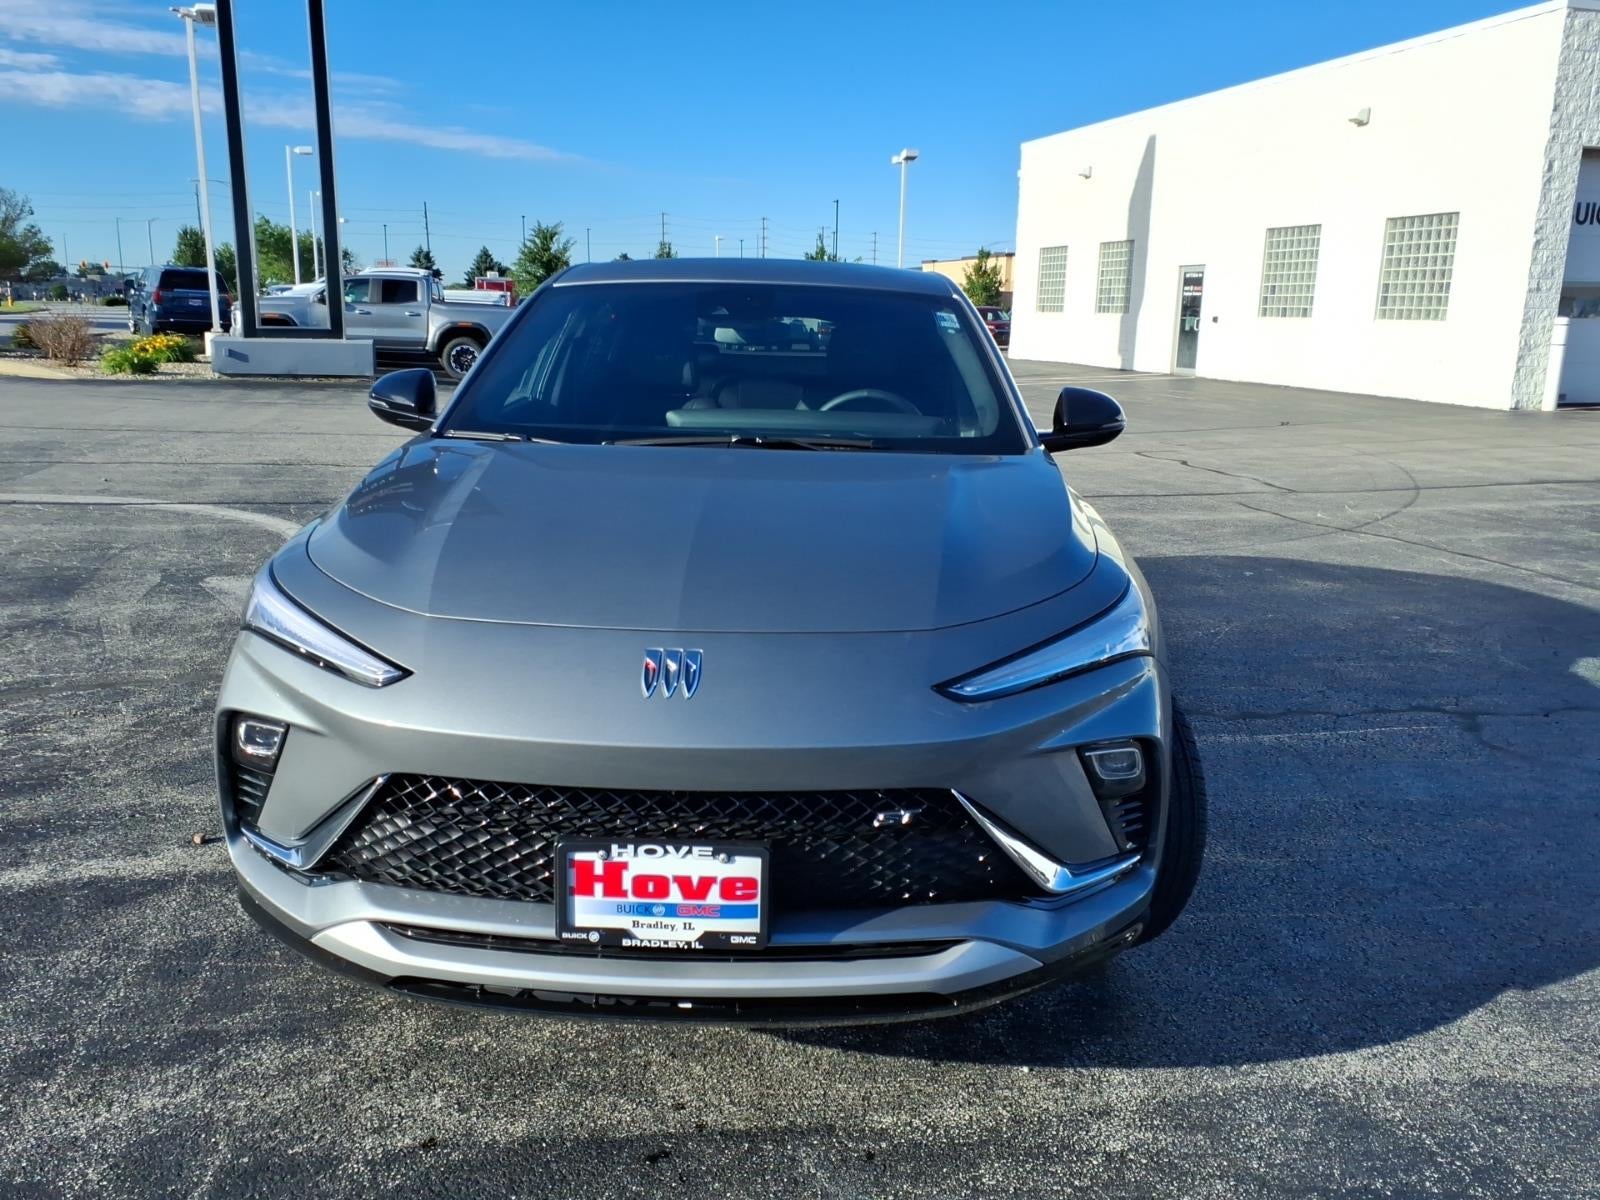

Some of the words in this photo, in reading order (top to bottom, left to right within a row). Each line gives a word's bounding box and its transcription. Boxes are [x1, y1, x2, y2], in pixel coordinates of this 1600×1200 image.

[611, 843, 713, 860] HOVE
[568, 860, 758, 901] Hove
[616, 904, 651, 914] BUICK
[676, 903, 720, 917] GMC
[632, 920, 678, 932] Bradley,
[683, 922, 695, 930] IL
[622, 938, 688, 949] BRADLEY,
[691, 941, 704, 949] IL
[730, 935, 757, 944] GMC
